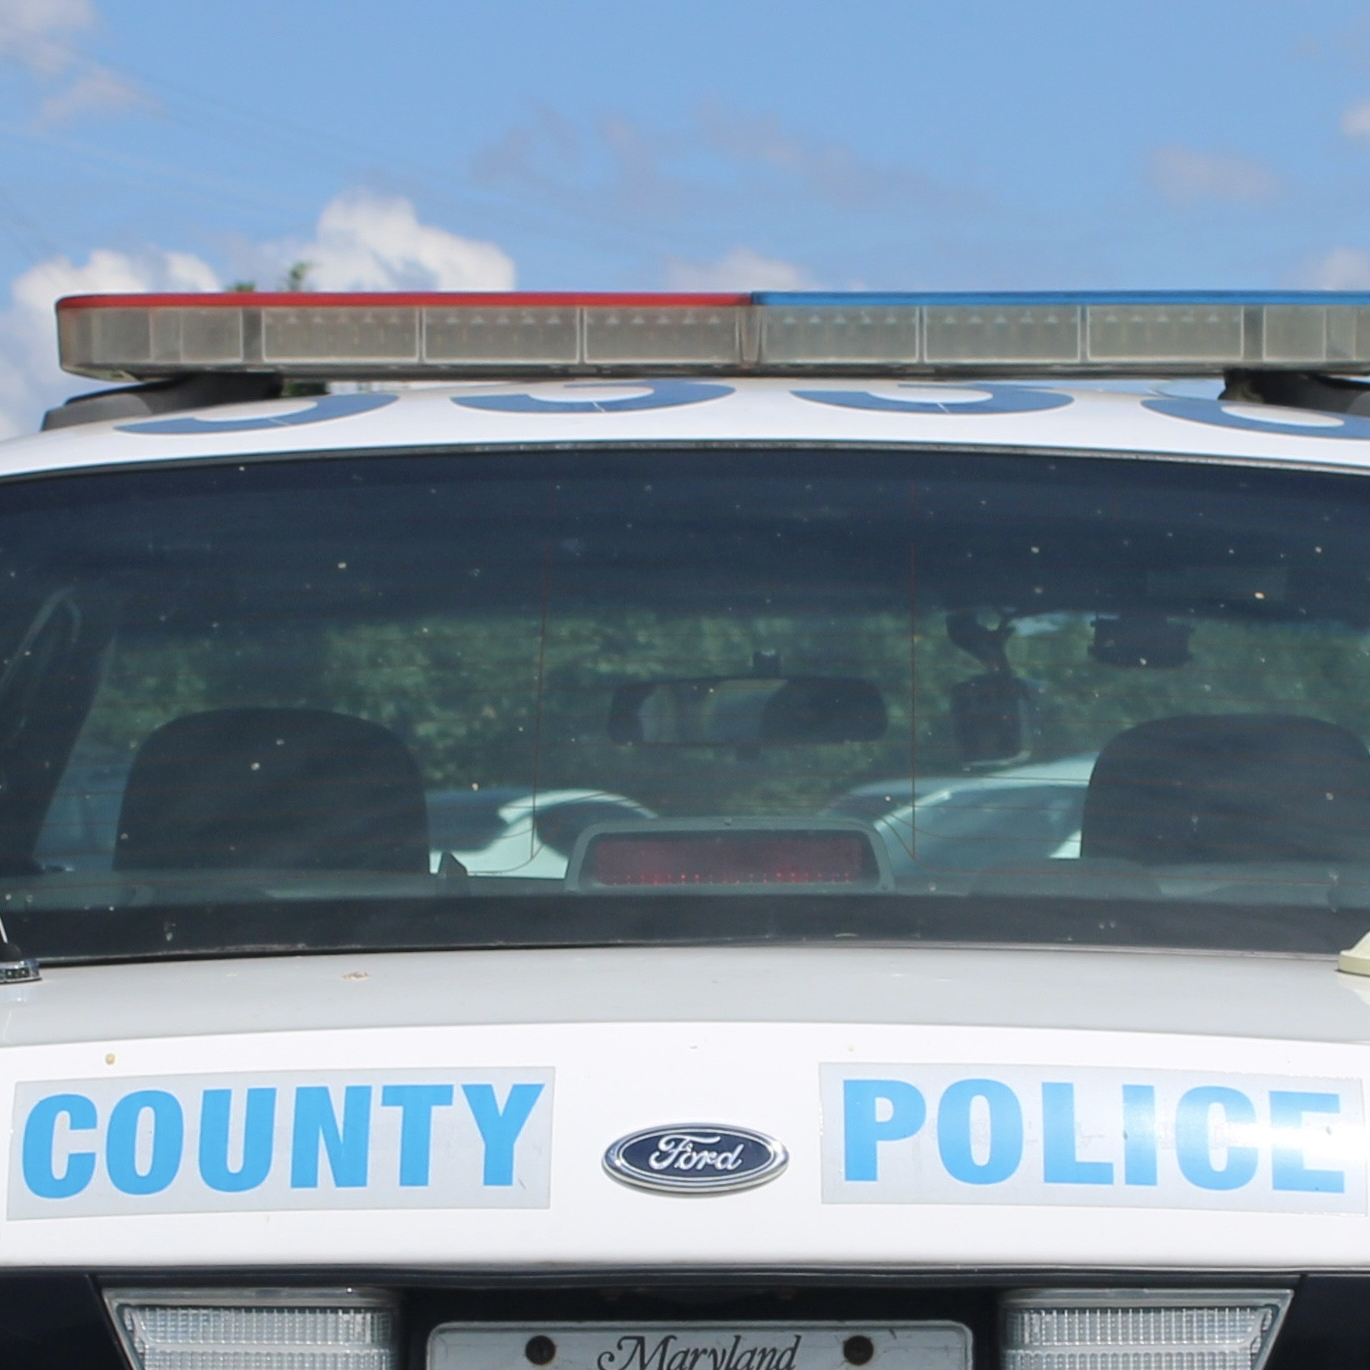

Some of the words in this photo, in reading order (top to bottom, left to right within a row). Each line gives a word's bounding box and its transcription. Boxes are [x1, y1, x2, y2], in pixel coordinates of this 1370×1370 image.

[20, 1082, 546, 1199] COUNTY
[649, 1134, 745, 1170] Ford
[842, 1078, 1348, 1196] POLICE
